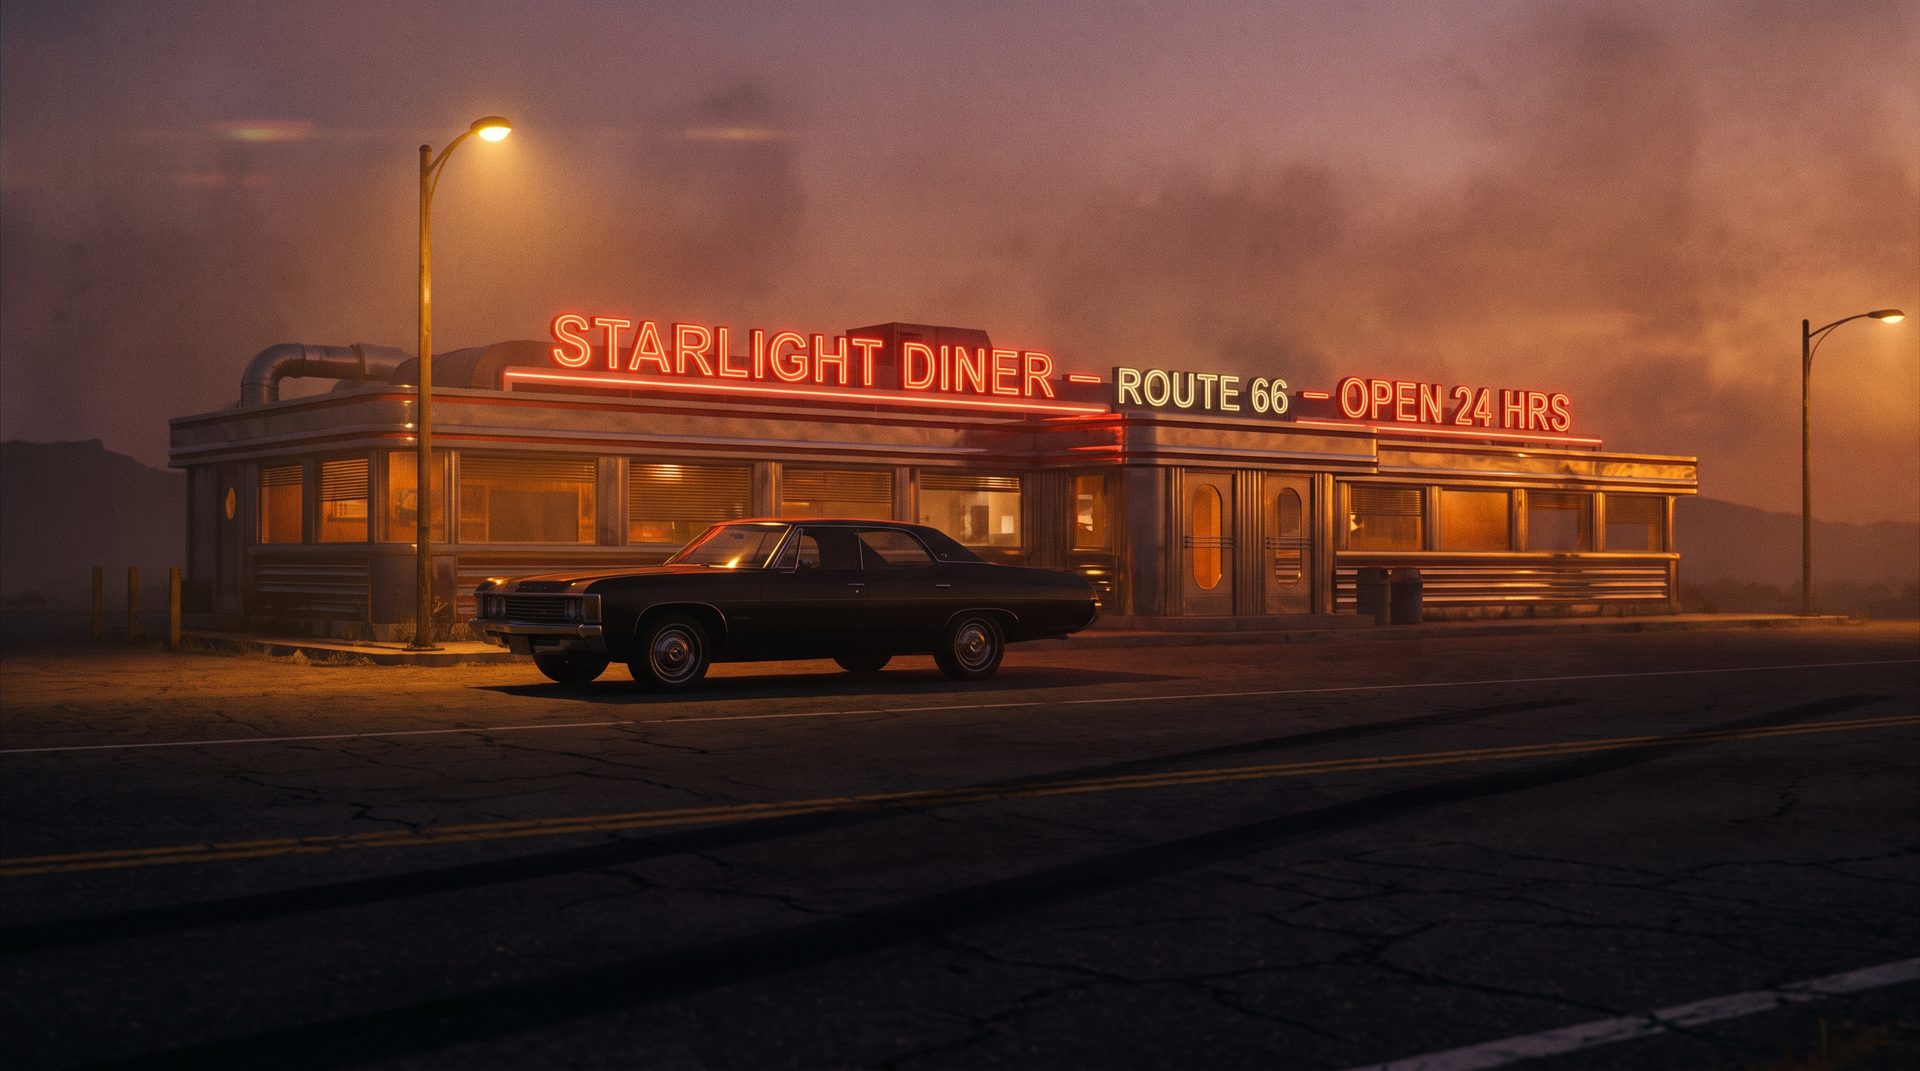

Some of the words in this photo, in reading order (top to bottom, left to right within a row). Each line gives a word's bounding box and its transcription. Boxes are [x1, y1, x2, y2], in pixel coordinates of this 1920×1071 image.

[552, 314, 883, 386] STARLIGHT
[904, 342, 1055, 398] DINER
[1118, 367, 1240, 411] ROUTE
[1252, 377, 1288, 414] 66
[1340, 377, 1442, 424] OPEN
[1455, 386, 1493, 427] 24
[1504, 390, 1571, 432] HRS
